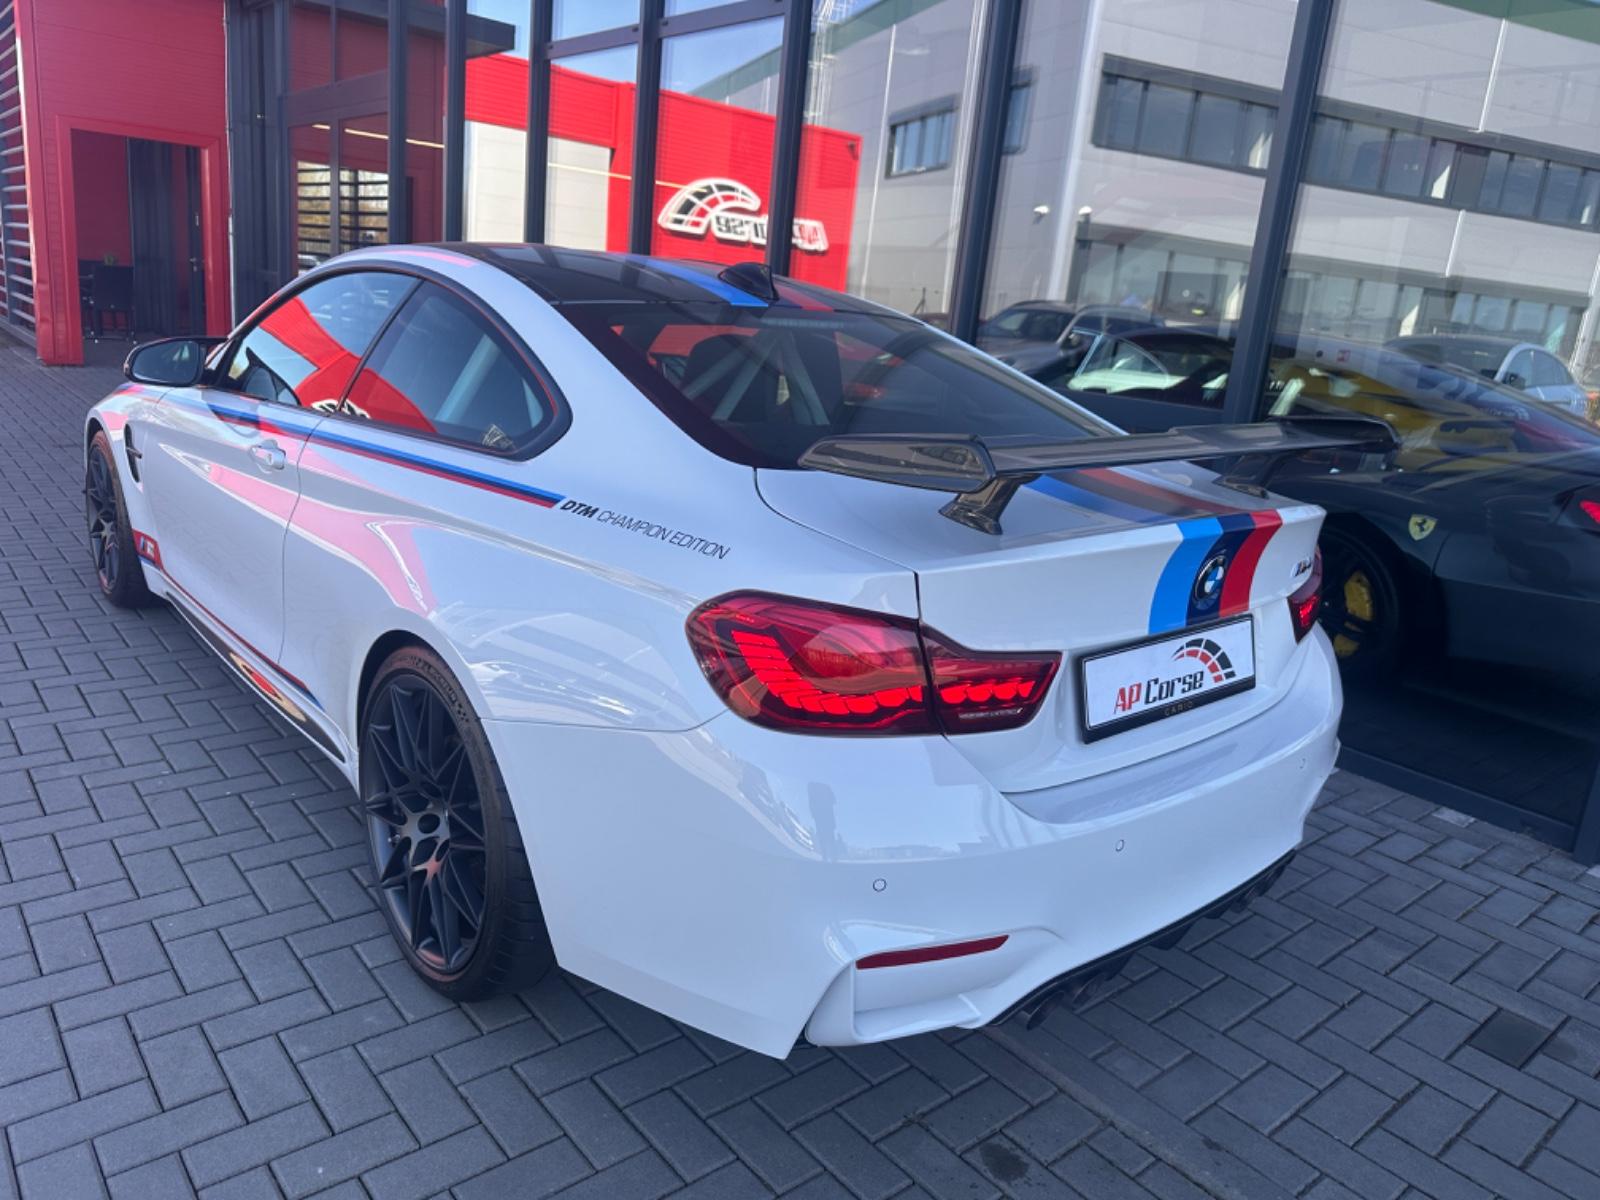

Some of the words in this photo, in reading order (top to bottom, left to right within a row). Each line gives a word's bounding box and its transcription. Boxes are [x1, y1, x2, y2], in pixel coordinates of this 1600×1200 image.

[560, 500, 599, 518] DTM
[597, 510, 671, 541] CHAMPION
[669, 531, 730, 559] EDITION
[1114, 682, 1142, 714] AP
[1144, 671, 1204, 705] Corse
